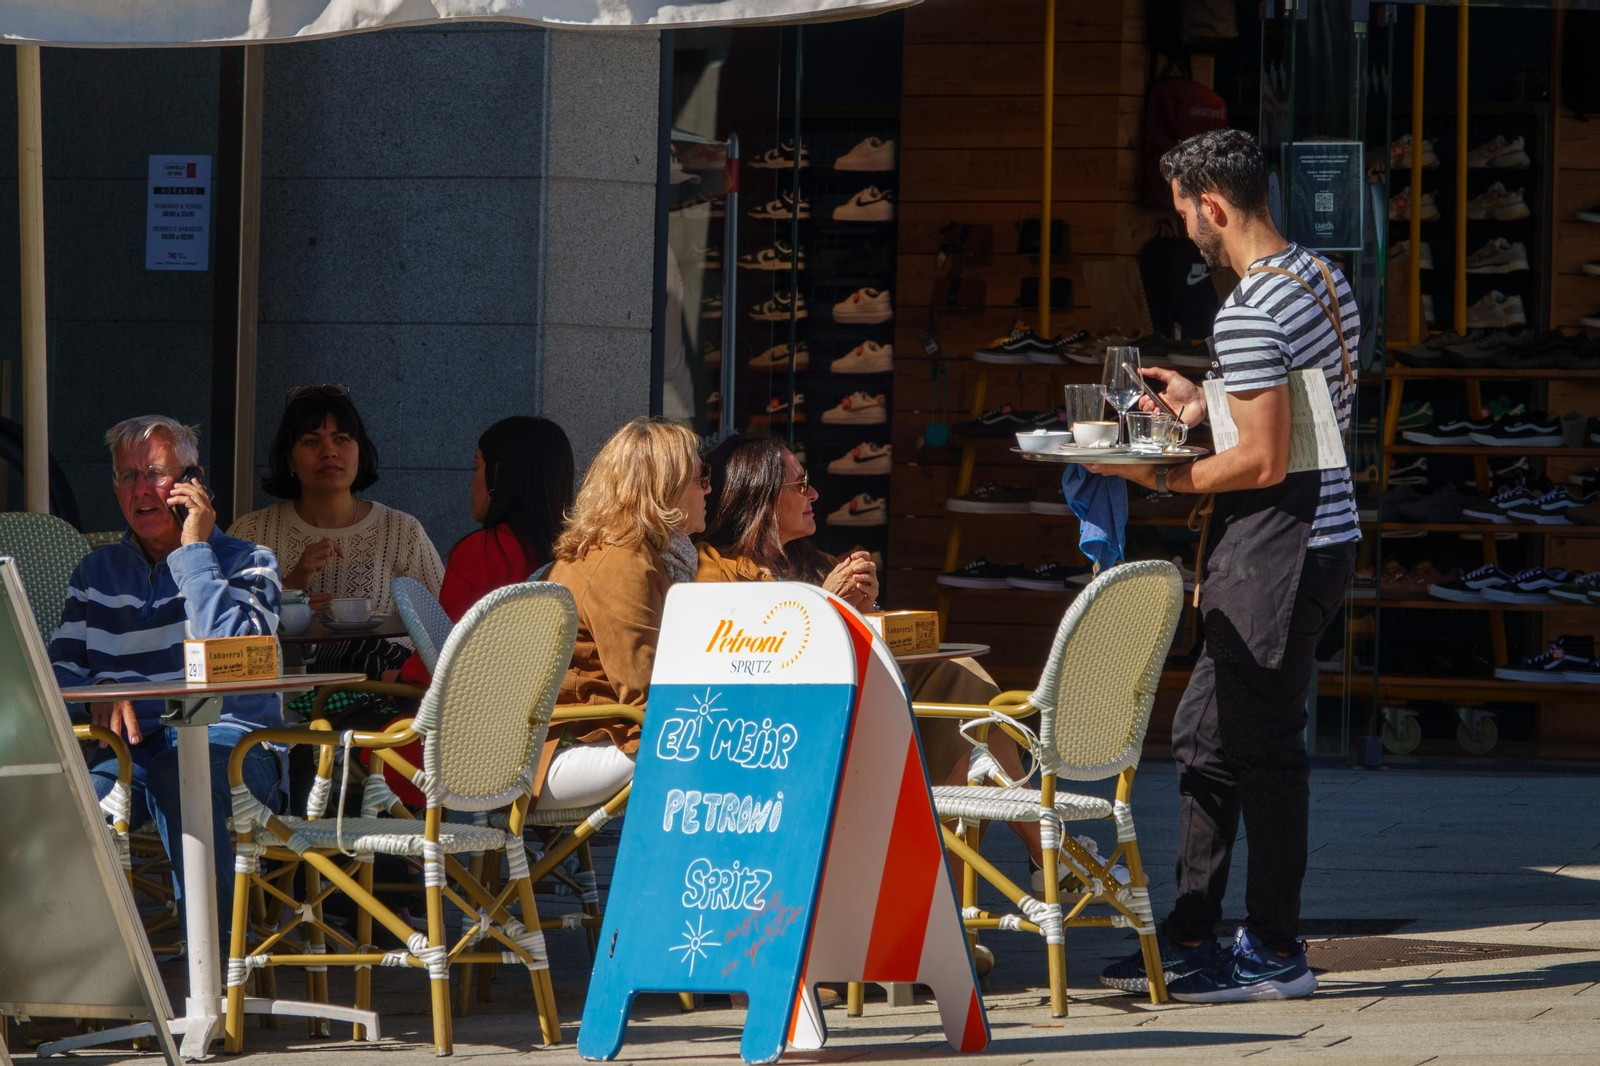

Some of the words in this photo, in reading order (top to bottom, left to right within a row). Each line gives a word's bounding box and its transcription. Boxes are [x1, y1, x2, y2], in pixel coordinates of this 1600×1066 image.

[705, 619, 787, 653] Petroni
[188, 663, 197, 677] 29
[730, 660, 773, 676] SPRITZ
[657, 718, 700, 762] EL
